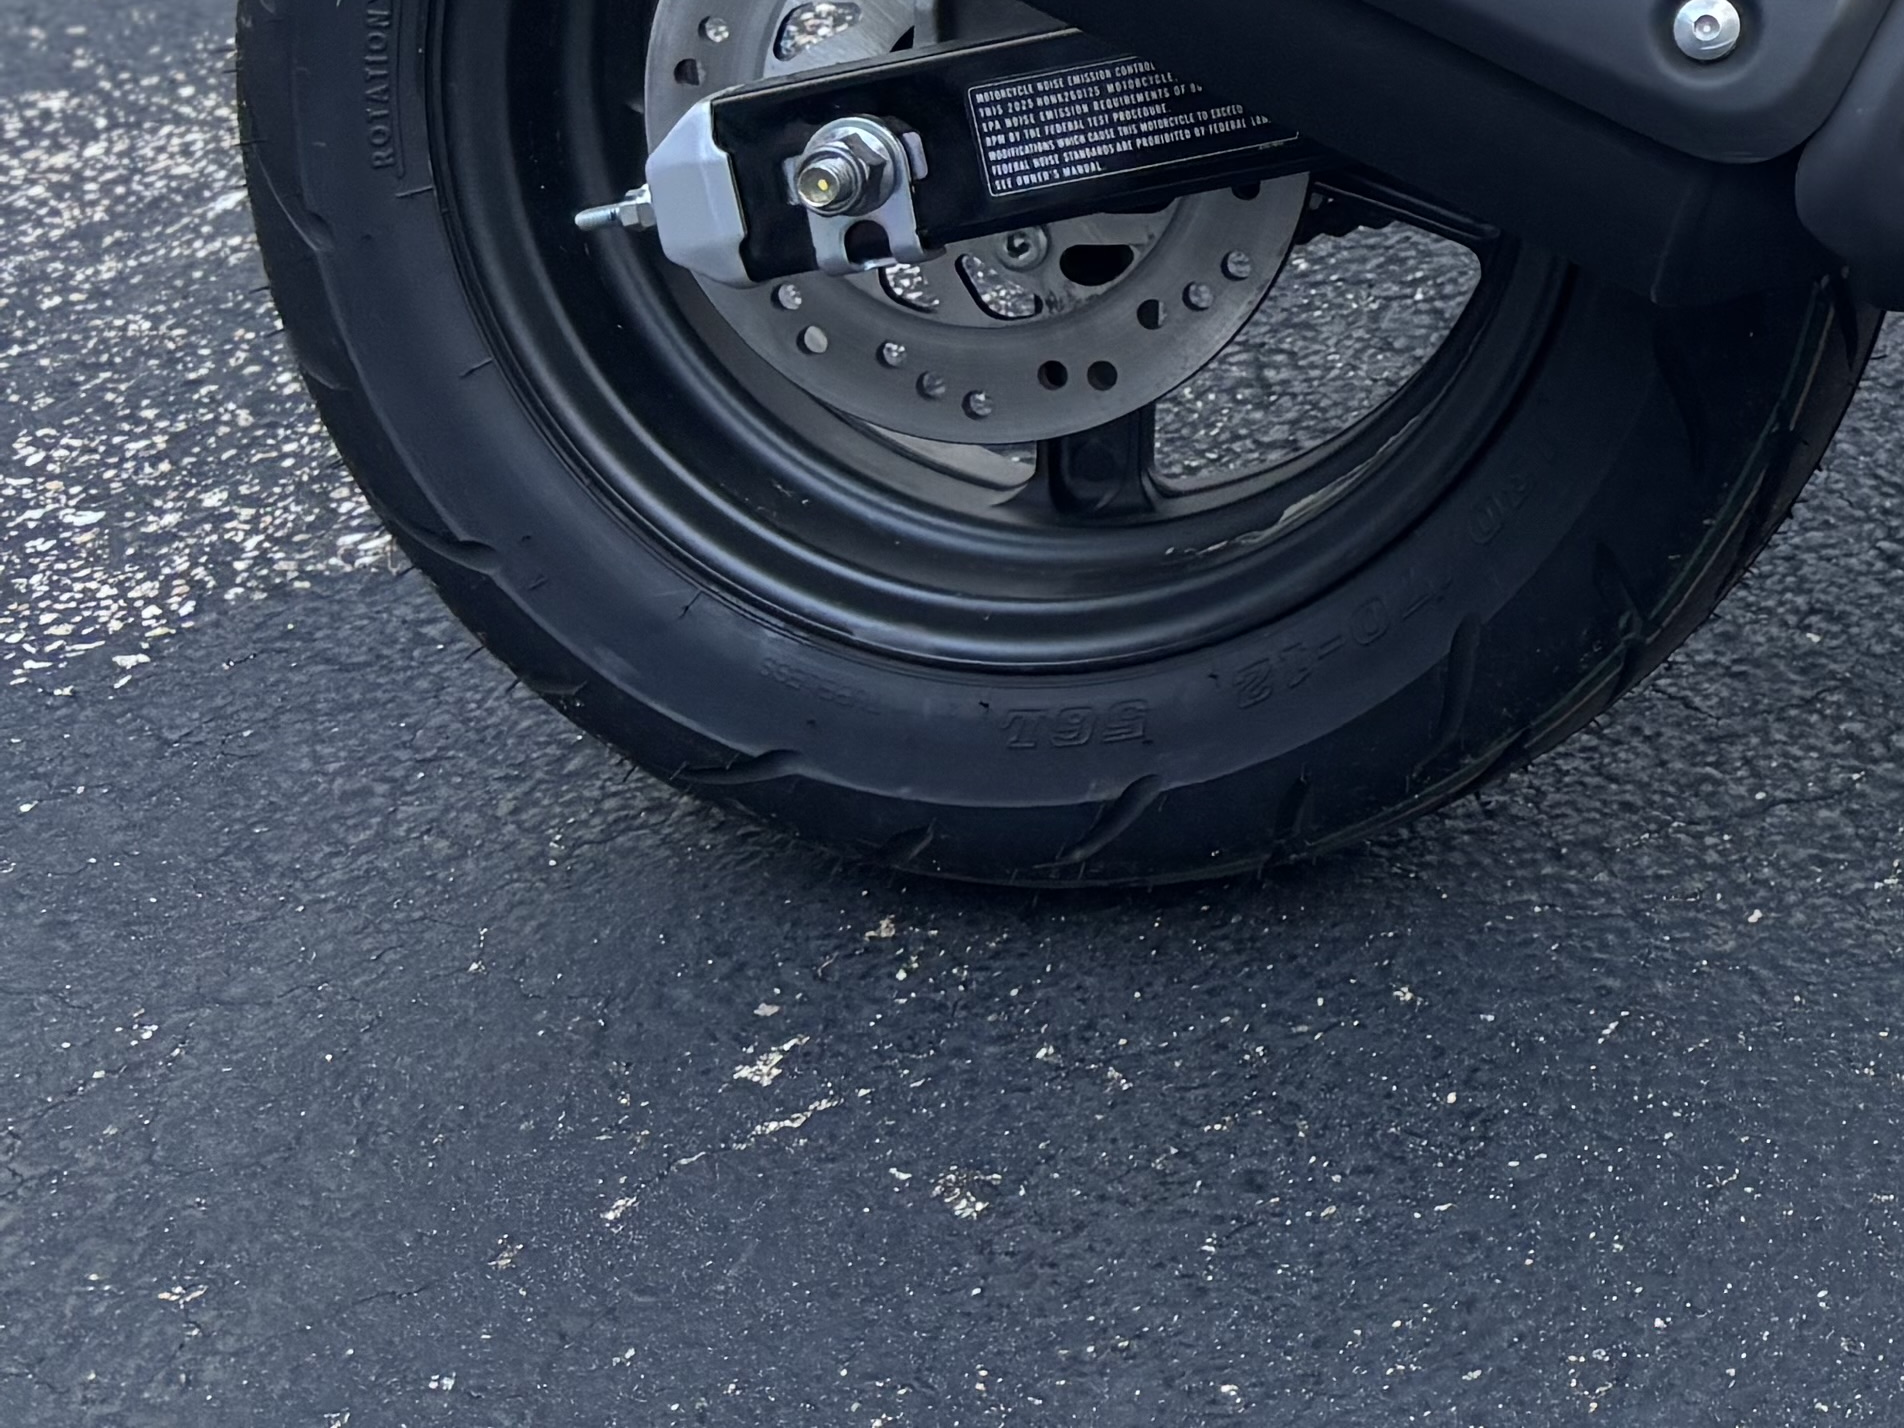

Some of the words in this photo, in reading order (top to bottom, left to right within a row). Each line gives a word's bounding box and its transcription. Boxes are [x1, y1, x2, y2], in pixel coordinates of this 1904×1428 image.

[363, 7, 394, 168] ROTATION
[975, 84, 1034, 104] MOTORCYCLE
[1036, 77, 1064, 92] NOISE
[1067, 68, 1112, 86] EMISSION
[979, 104, 1003, 118] THIS
[1007, 98, 1034, 113] 2025
[982, 120, 1001, 133] EPA
[1004, 113, 1035, 128] NOISE
[1039, 103, 1089, 122] EMISSION
[1093, 87, 1170, 111] REQUIREMENTS
[1173, 83, 1186, 95] OF
[985, 134, 1006, 147] RPM
[1008, 131, 1021, 143] BY
[1024, 127, 1041, 140] THE
[1044, 119, 1084, 136] FEDERAL
[1087, 114, 1110, 127] TEST
[988, 139, 1055, 162] MODIFICATIONS
[1056, 133, 1086, 148] WHICH
[1087, 127, 1115, 142] CAUSE
[1117, 123, 1138, 136] THIS
[1139, 112, 1195, 132] MOTORCYCLE
[1197, 109, 1209, 121] TO
[1210, 102, 1244, 118] EXCEED
[991, 159, 1030, 177] FEDERAL
[1032, 153, 1060, 169] NOISE
[1063, 143, 1115, 163] STANDARDS
[1115, 139, 1133, 152] ARE
[1135, 128, 1191, 148] PROHIBITED
[1193, 125, 1205, 137] BY
[1208, 117, 1246, 134] FEDERAL
[994, 178, 1013, 191] SEE
[1015, 168, 1060, 187] OWNER'S
